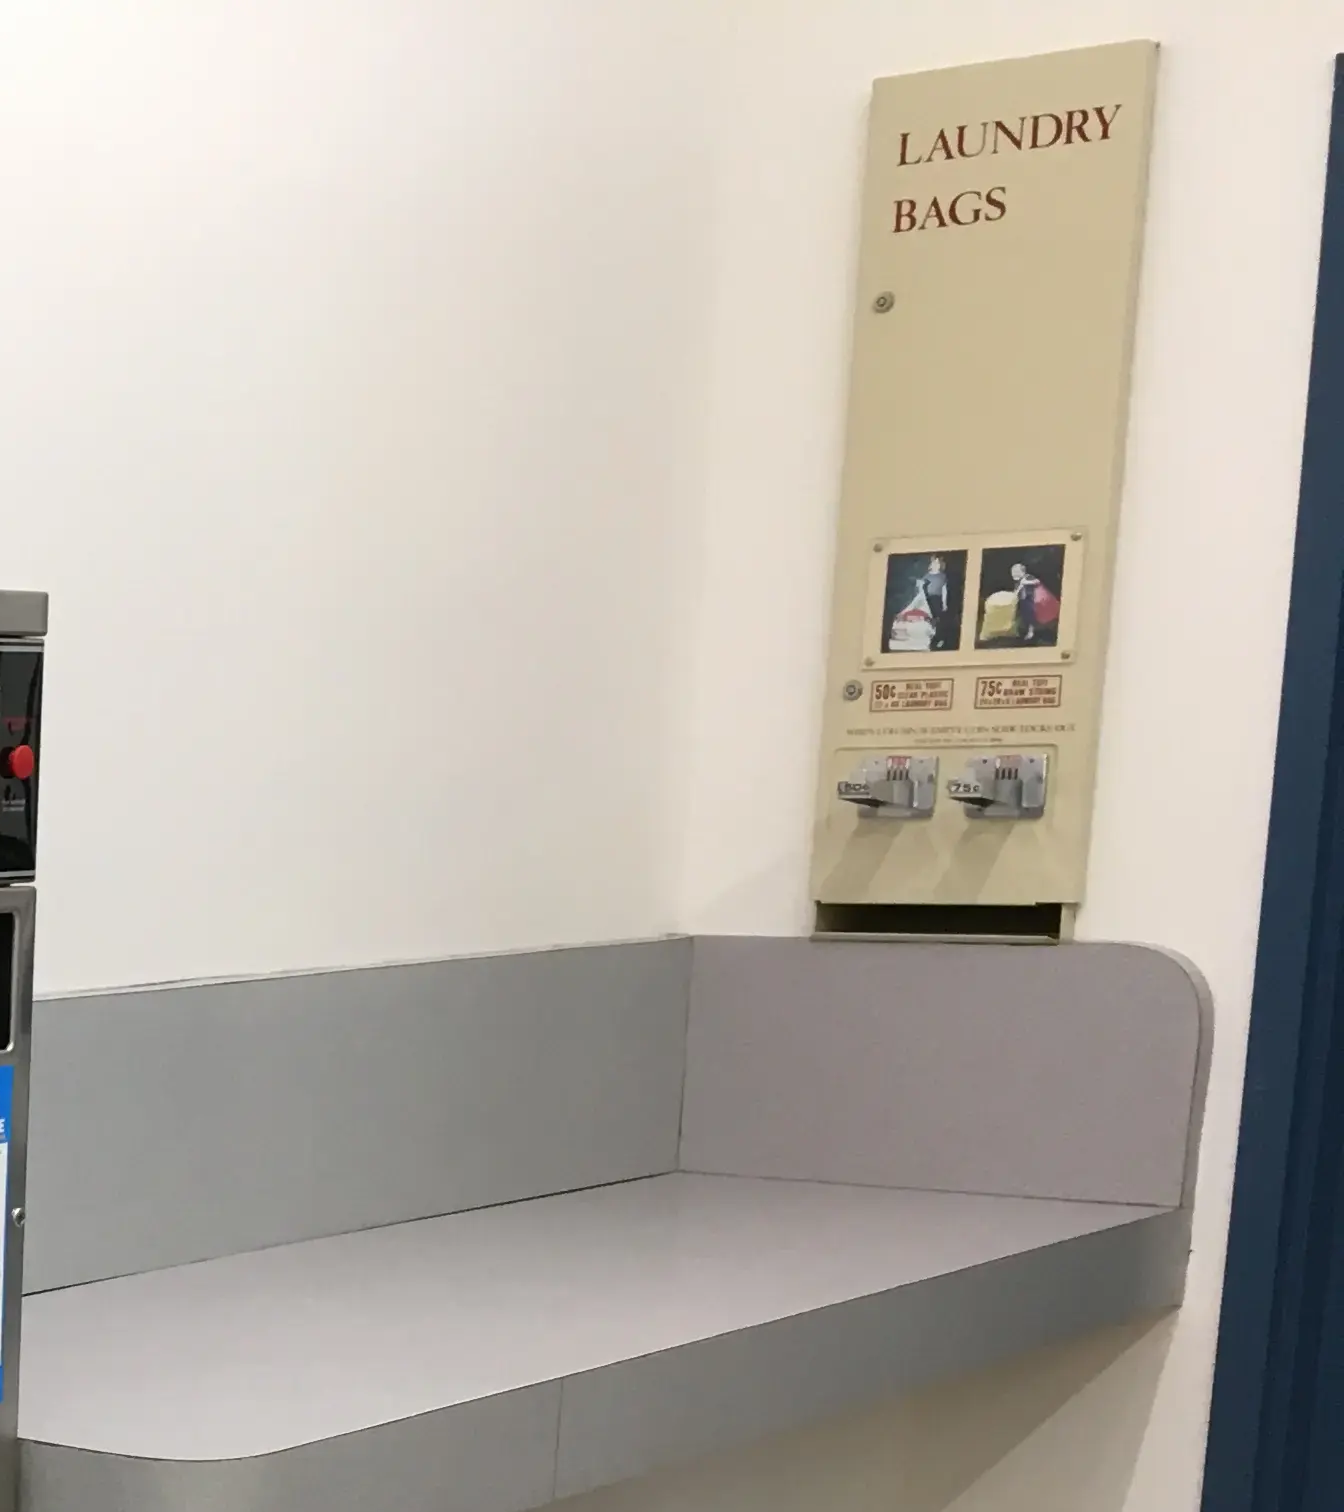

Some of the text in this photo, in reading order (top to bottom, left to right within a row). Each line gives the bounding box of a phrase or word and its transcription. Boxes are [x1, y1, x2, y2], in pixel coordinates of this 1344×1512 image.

[896, 104, 1122, 167] LAUNDRY
[892, 186, 1007, 233] BAGS
[875, 684, 896, 700] 50¢
[980, 681, 1003, 697] 75¢
